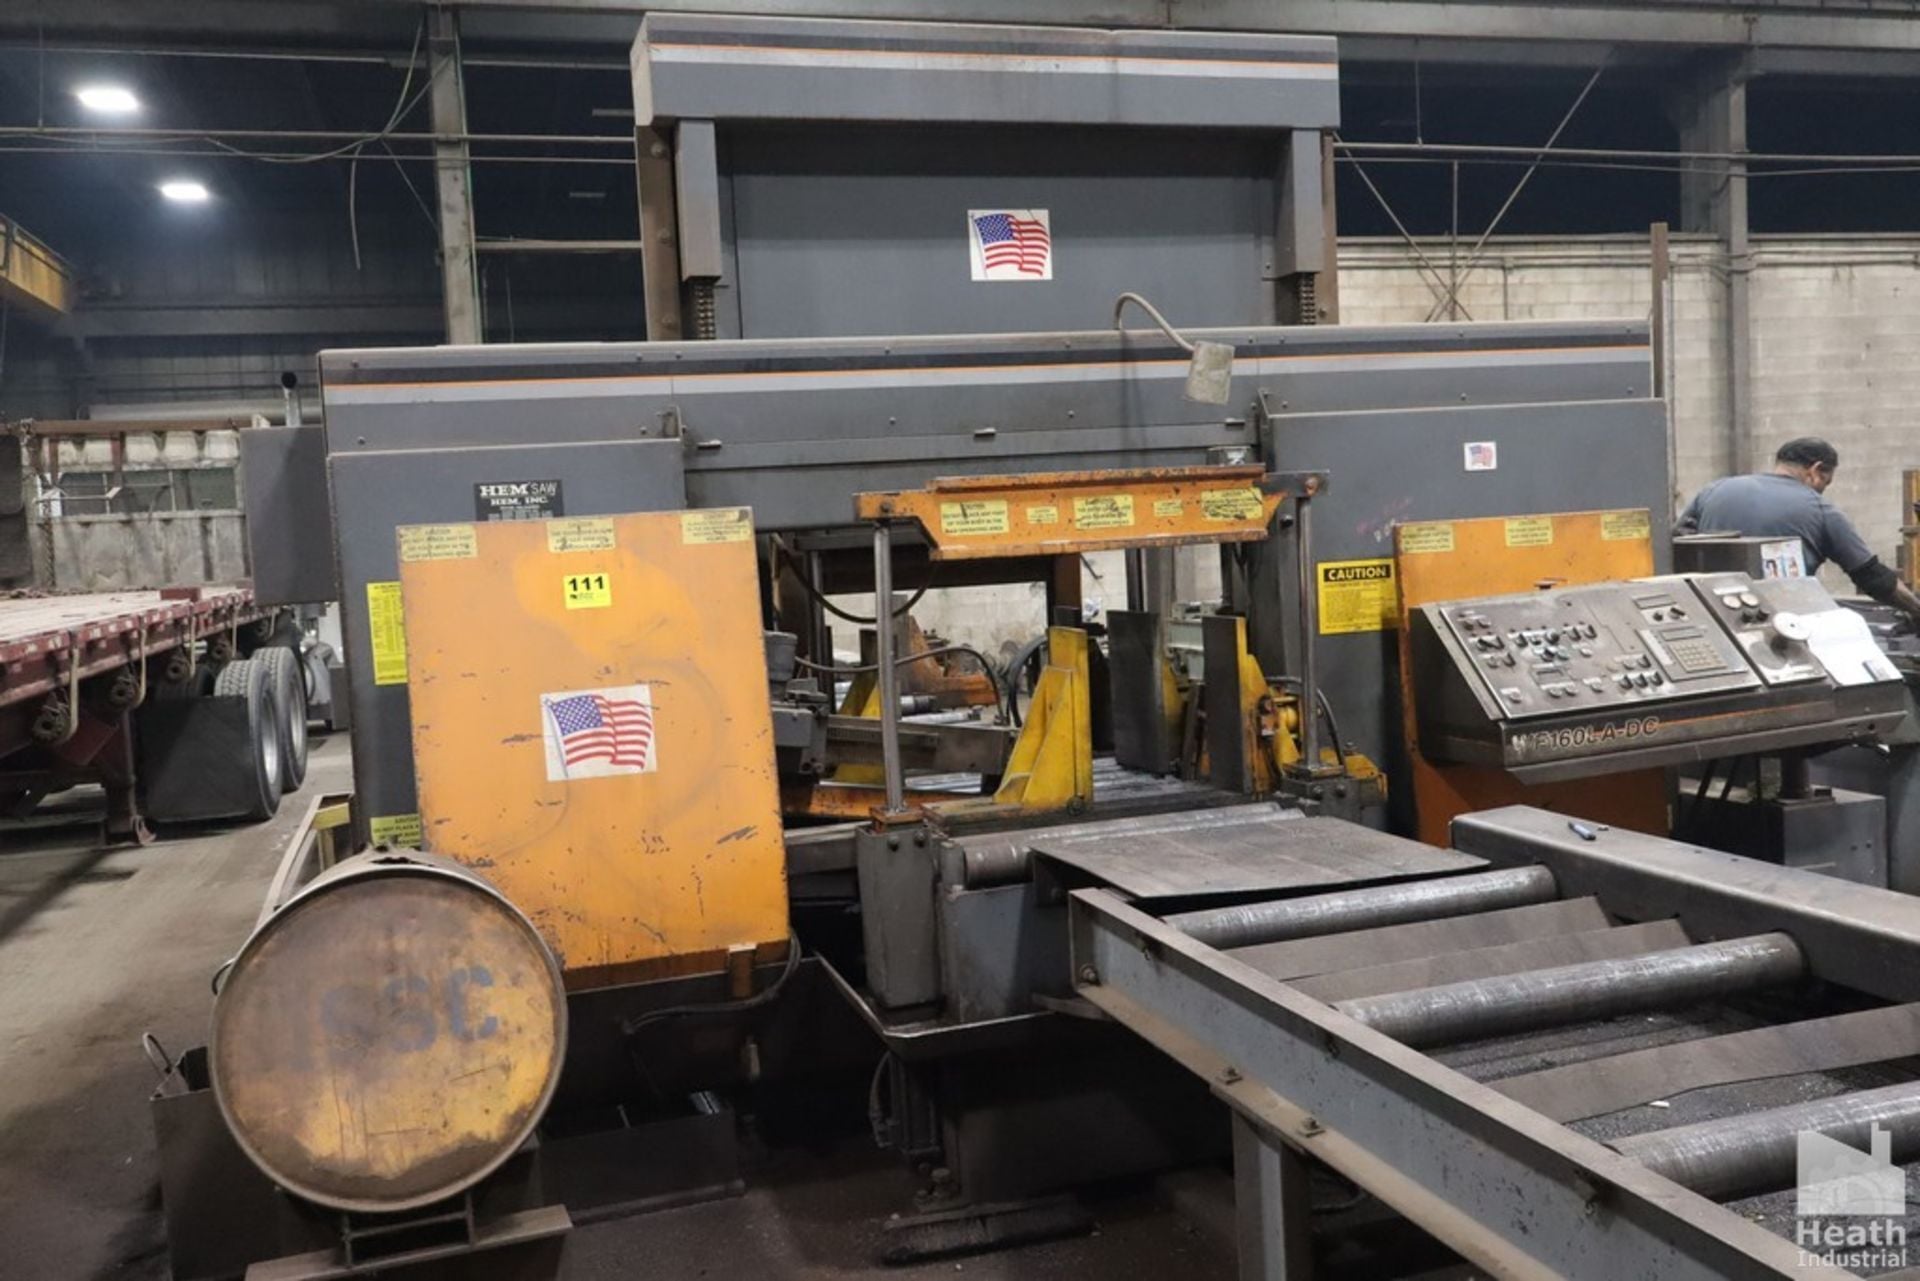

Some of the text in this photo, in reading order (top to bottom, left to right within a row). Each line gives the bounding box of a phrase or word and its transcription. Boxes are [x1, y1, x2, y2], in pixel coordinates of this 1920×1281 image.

[479, 481, 558, 497] HEM SAW
[1328, 566, 1387, 581] CAUTION
[568, 575, 604, 592] 111
